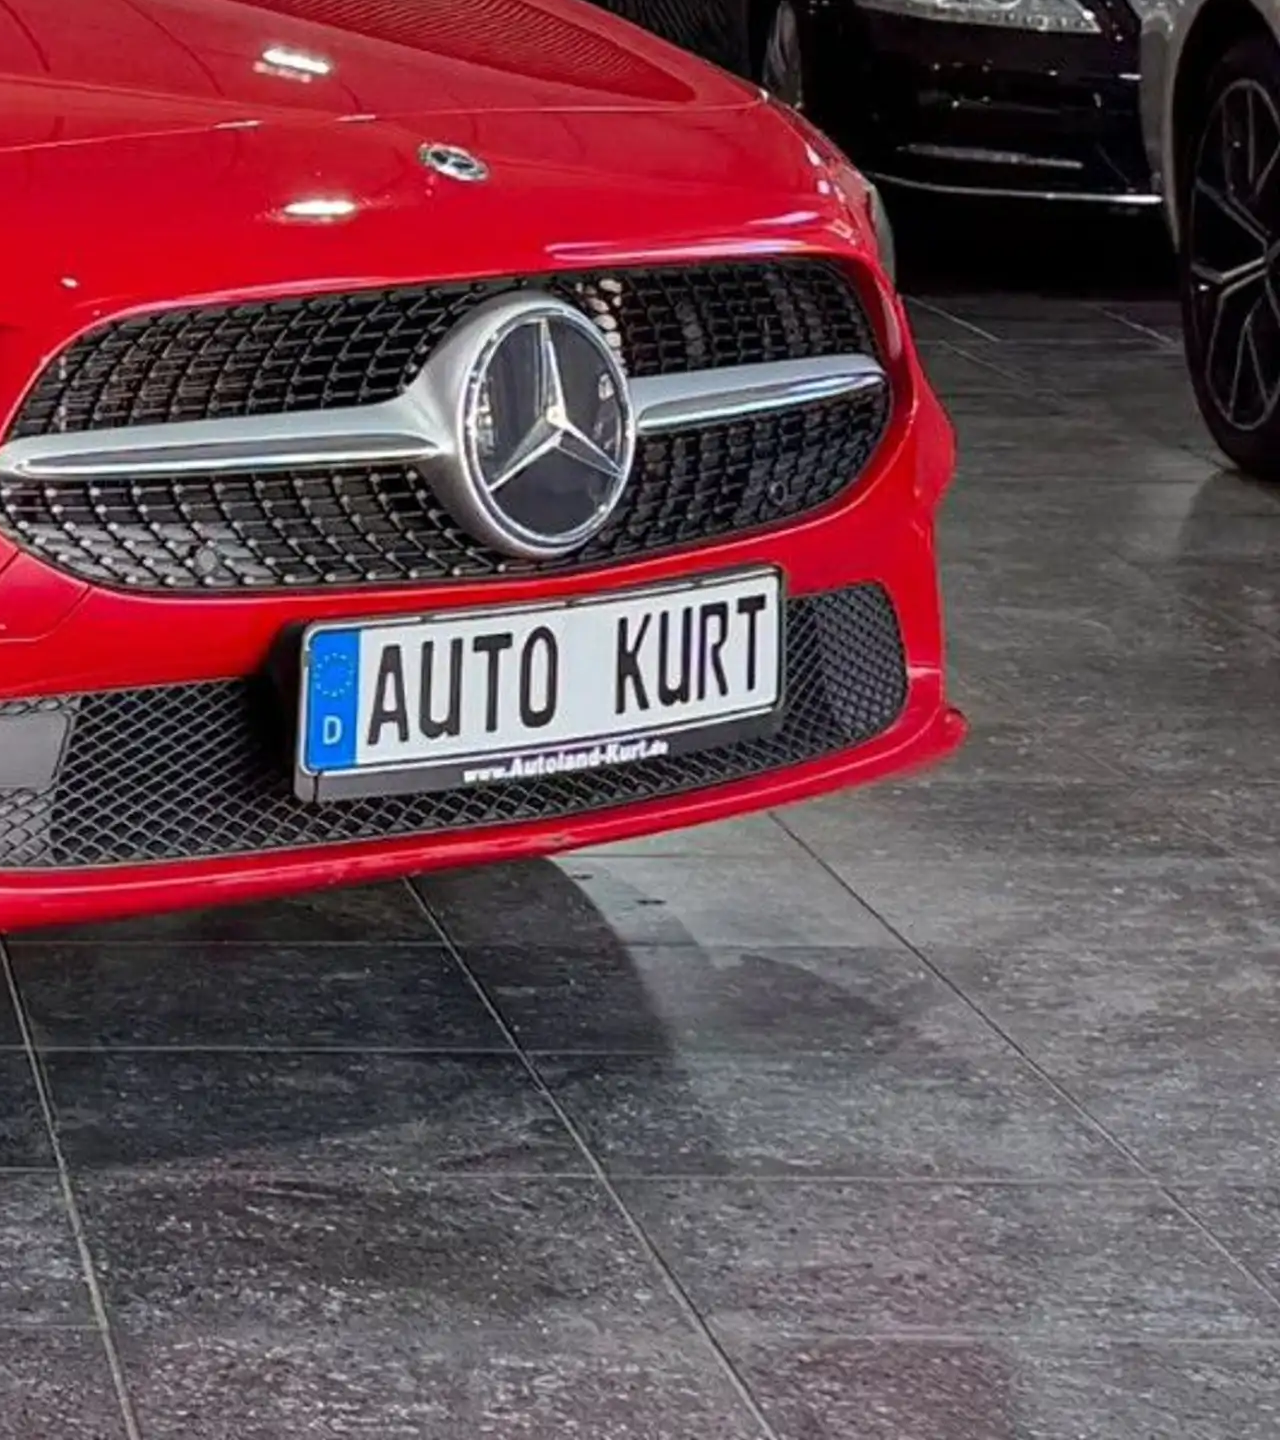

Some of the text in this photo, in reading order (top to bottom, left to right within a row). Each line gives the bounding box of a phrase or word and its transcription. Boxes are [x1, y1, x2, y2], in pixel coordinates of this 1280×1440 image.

[366, 593, 768, 746] AUTO KURT
[322, 714, 342, 745] D
